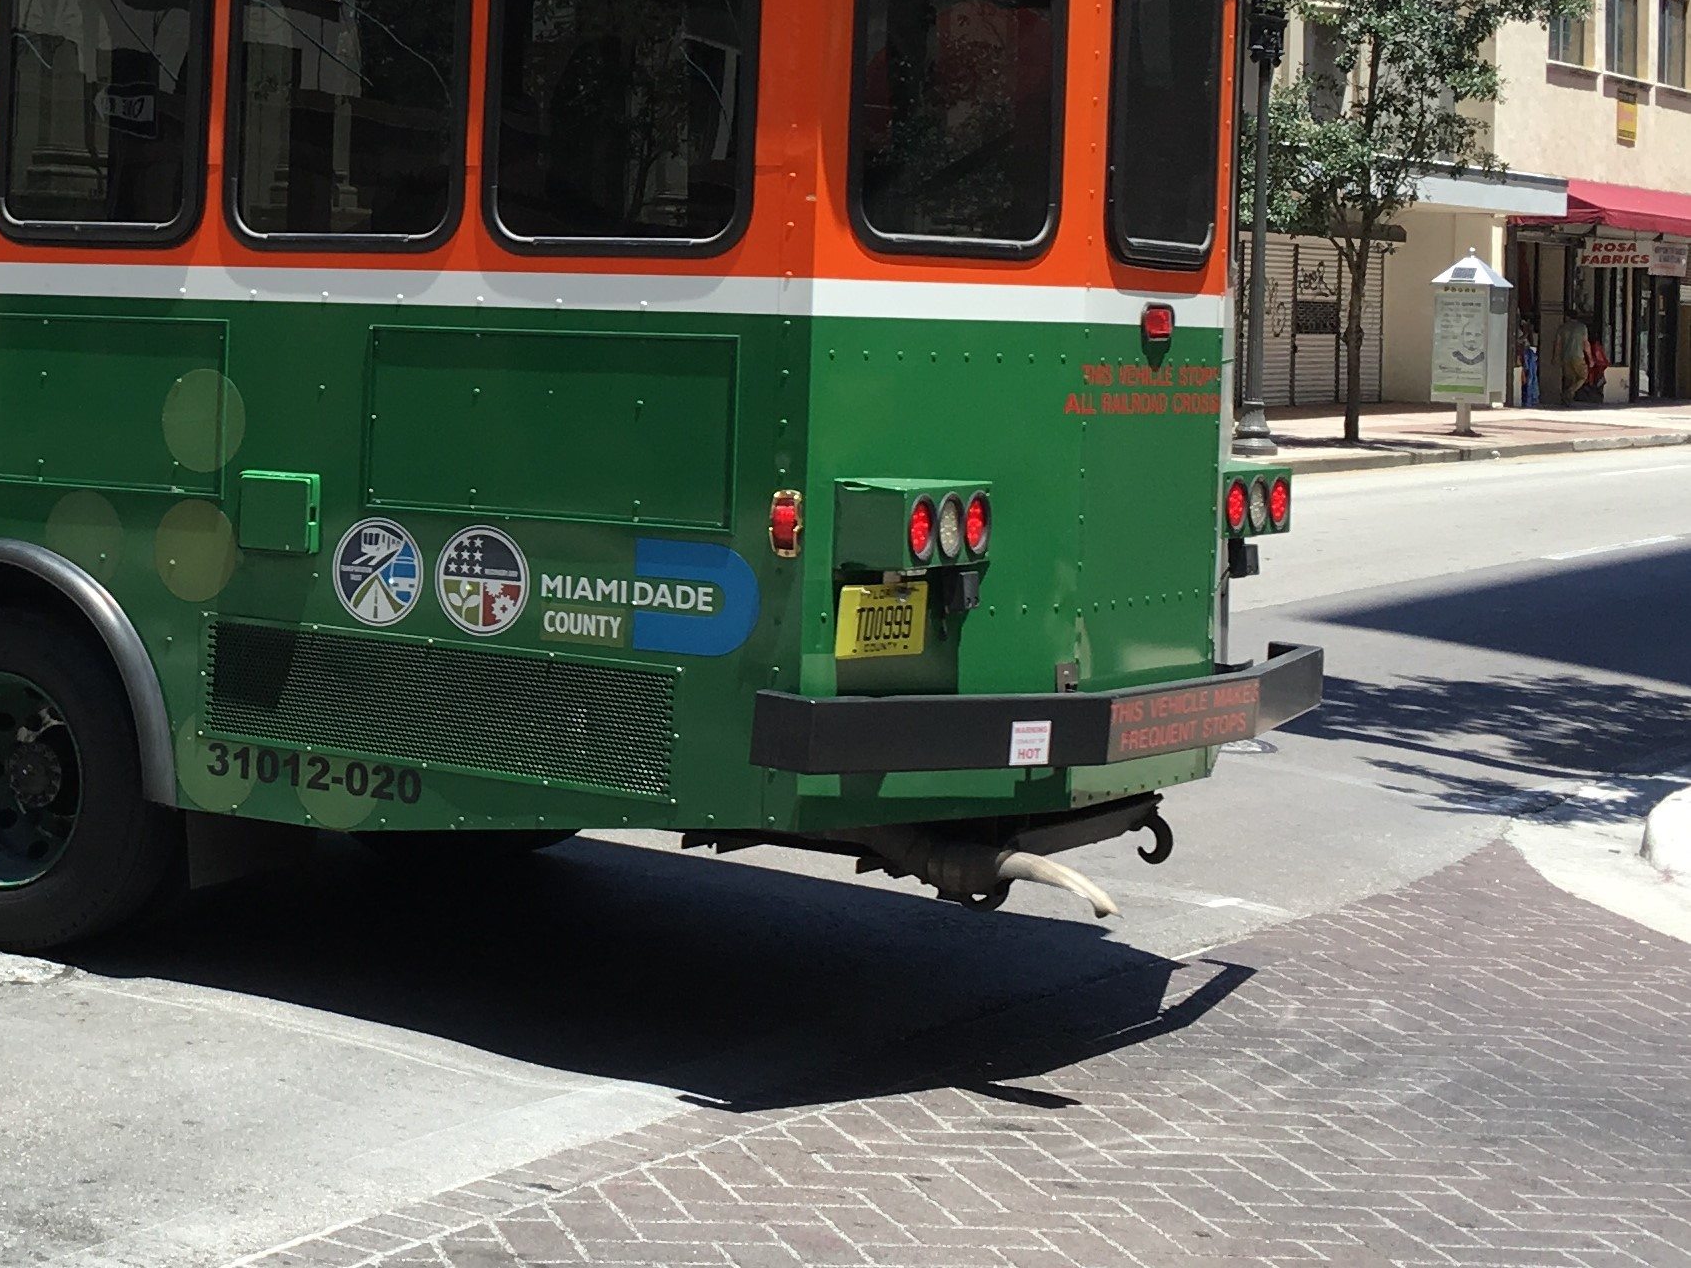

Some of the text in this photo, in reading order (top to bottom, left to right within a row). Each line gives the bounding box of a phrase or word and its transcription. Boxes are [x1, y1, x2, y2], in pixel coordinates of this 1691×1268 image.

[1581, 254, 1650, 264] FABRICS
[1592, 242, 1637, 252] ROSA
[1082, 364, 1114, 386] THIS
[1064, 393, 1097, 414] ALL
[1102, 393, 1168, 414] RAILROAD
[541, 573, 714, 612] MIAMI DADE
[543, 610, 621, 639] COUNTY
[1112, 682, 1259, 725] THIS VEHICLE MAKES
[1121, 712, 1247, 750] FREQUENT STOPS
[1018, 748, 1041, 759] HOT
[206, 742, 422, 804] 31012-020
